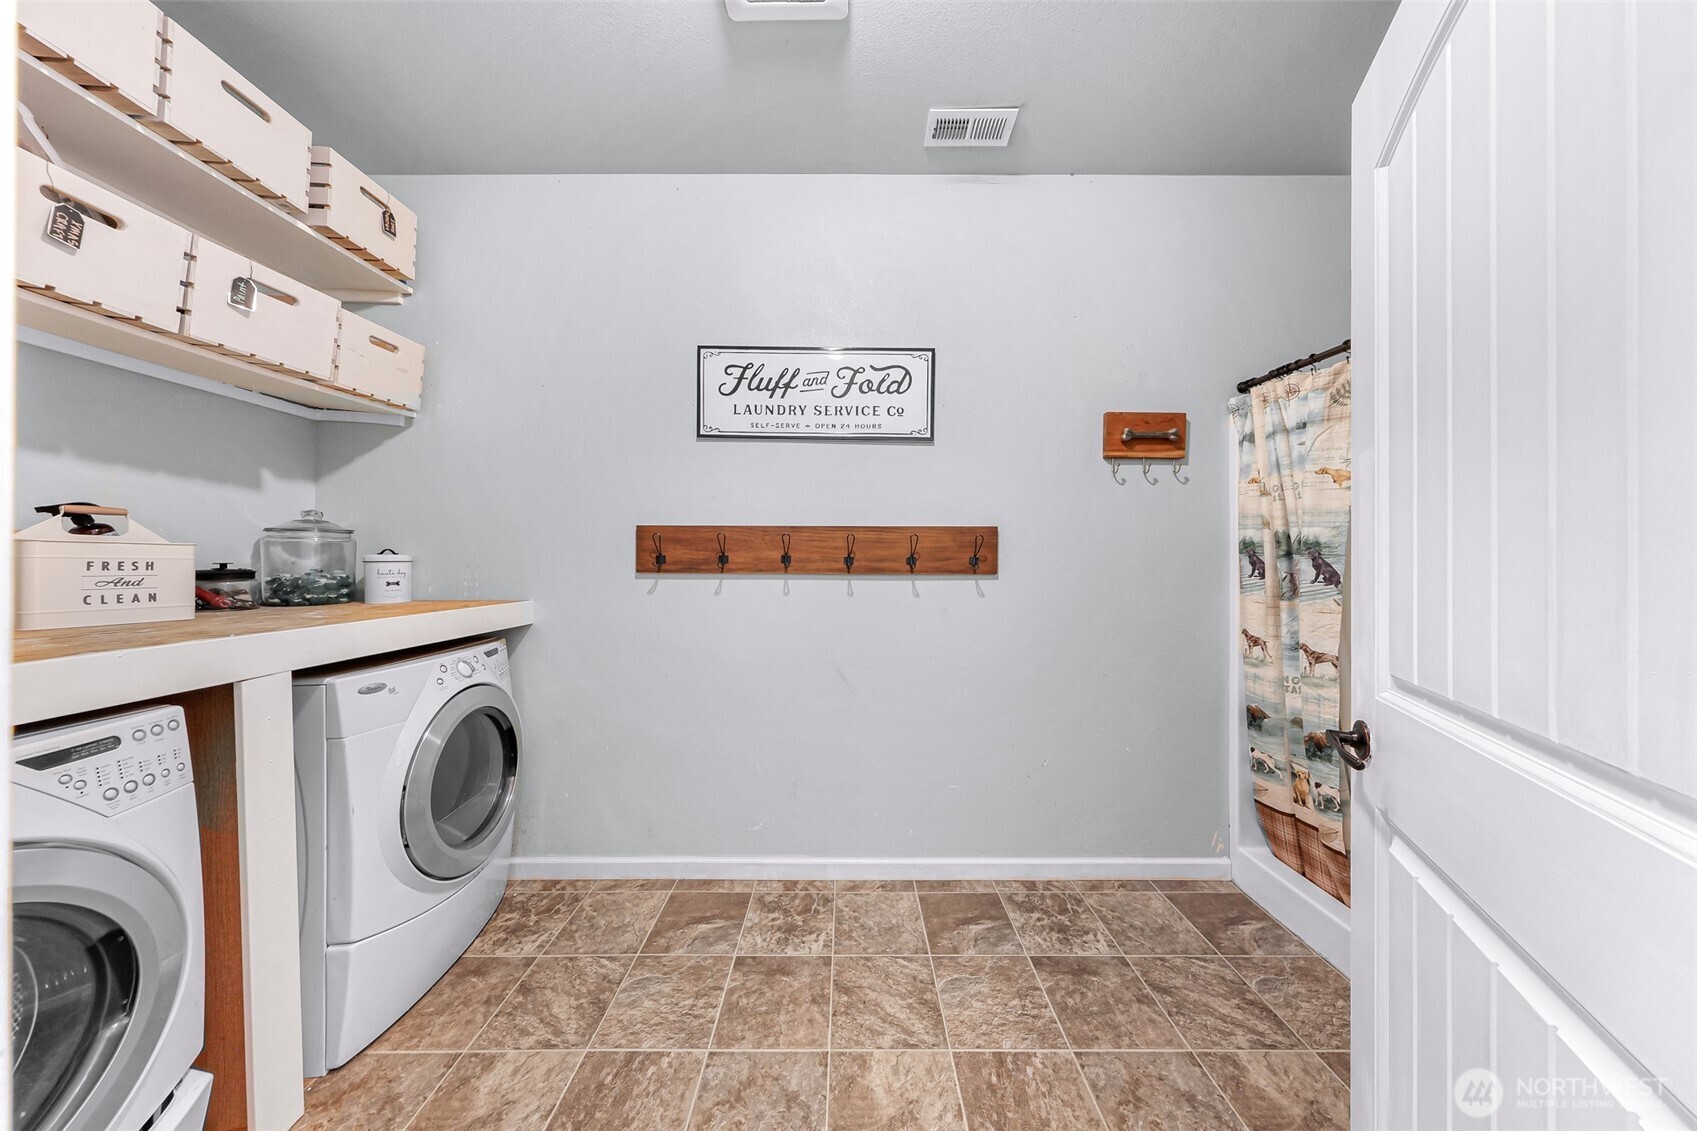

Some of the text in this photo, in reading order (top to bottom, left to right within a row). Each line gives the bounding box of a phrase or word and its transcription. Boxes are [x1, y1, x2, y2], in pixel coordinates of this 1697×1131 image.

[53, 212, 69, 239] CRAFT
[67, 219, 83, 246] XMAS
[718, 362, 912, 399] Fluff and Fold
[733, 404, 807, 415] LAUNDRY
[813, 405, 880, 416] SERVICE
[86, 561, 154, 571] FRESH
[94, 577, 145, 588] And
[82, 593, 157, 605] CLEAN
